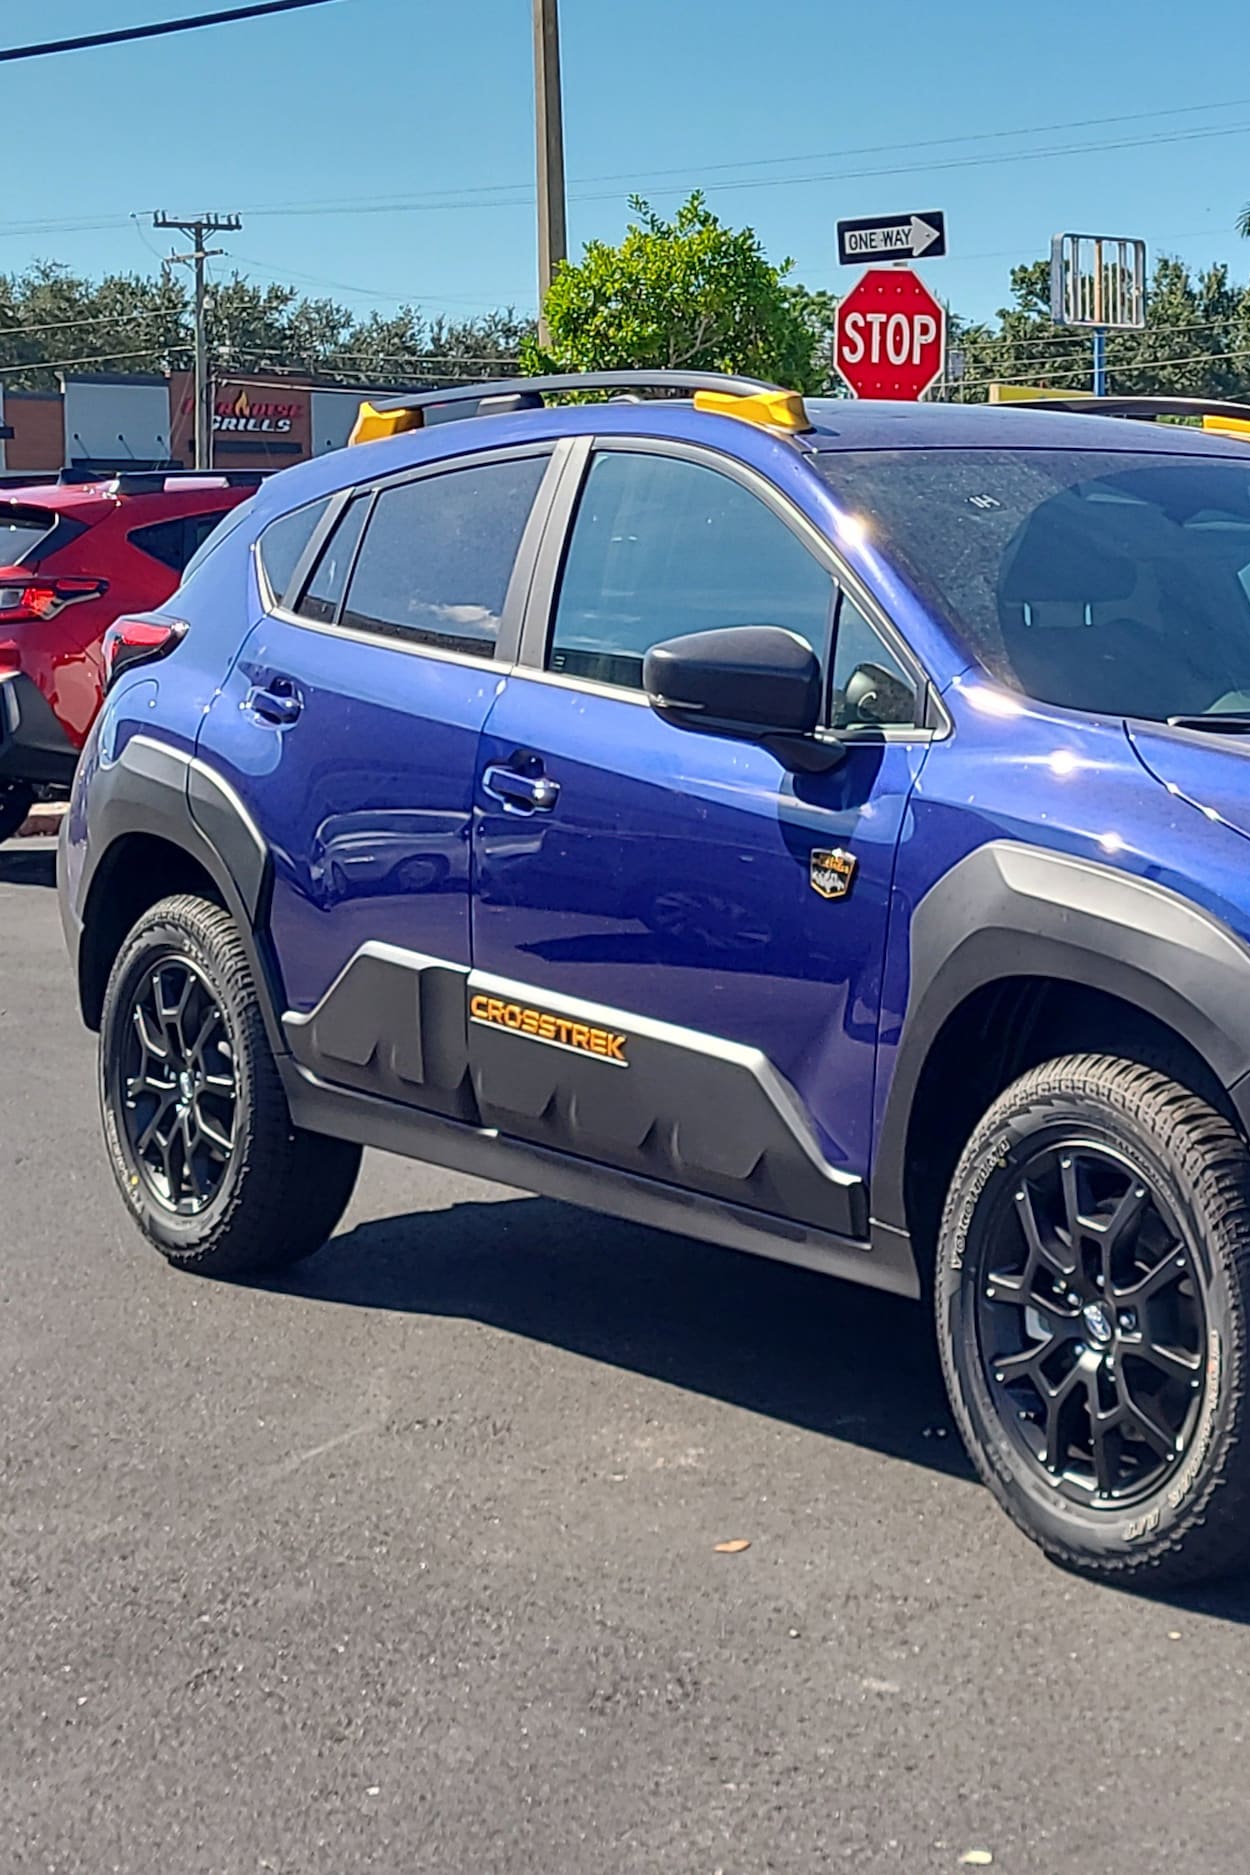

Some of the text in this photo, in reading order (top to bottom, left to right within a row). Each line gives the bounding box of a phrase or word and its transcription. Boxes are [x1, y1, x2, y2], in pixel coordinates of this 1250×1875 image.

[848, 227, 912, 251] ONE WAY
[842, 312, 936, 365] STOP
[470, 994, 627, 1060] CROSSTREK
